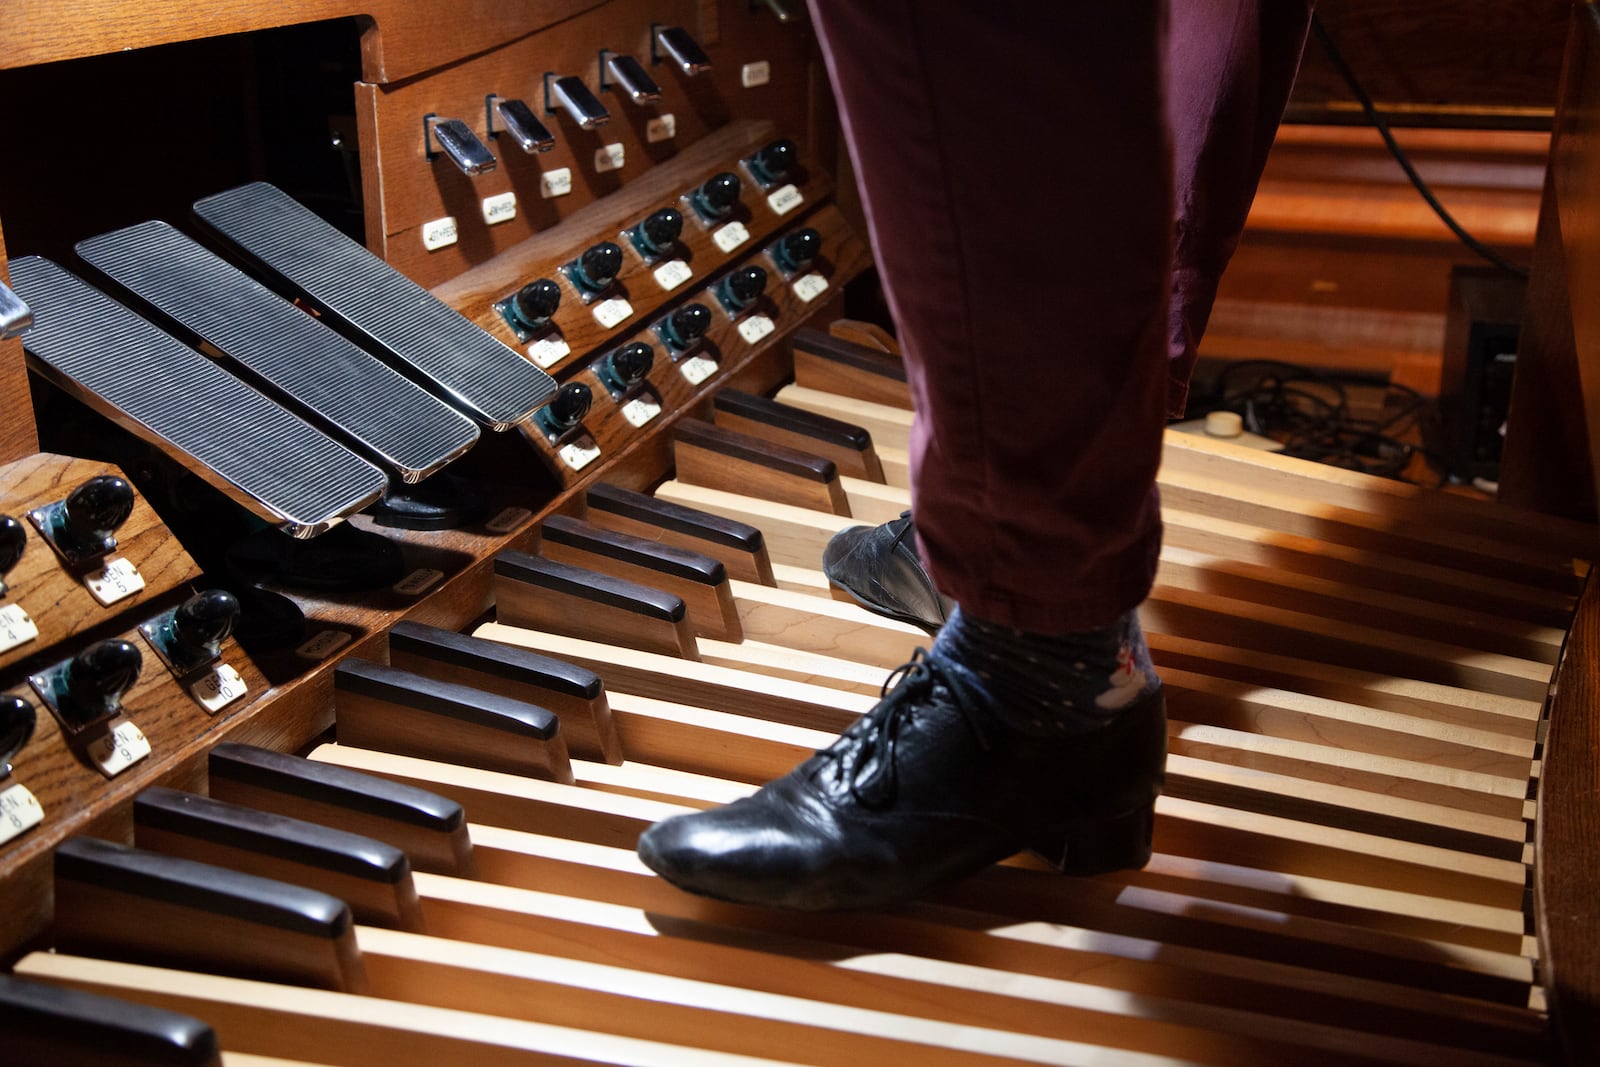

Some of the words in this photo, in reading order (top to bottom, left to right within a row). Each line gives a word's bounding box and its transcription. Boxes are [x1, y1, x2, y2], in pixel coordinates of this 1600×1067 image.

[116, 581, 127, 592] 5
[8, 629, 17, 640] 4
[218, 686, 233, 700] 10
[121, 748, 132, 760] 9
[10, 814, 22, 828] 8
